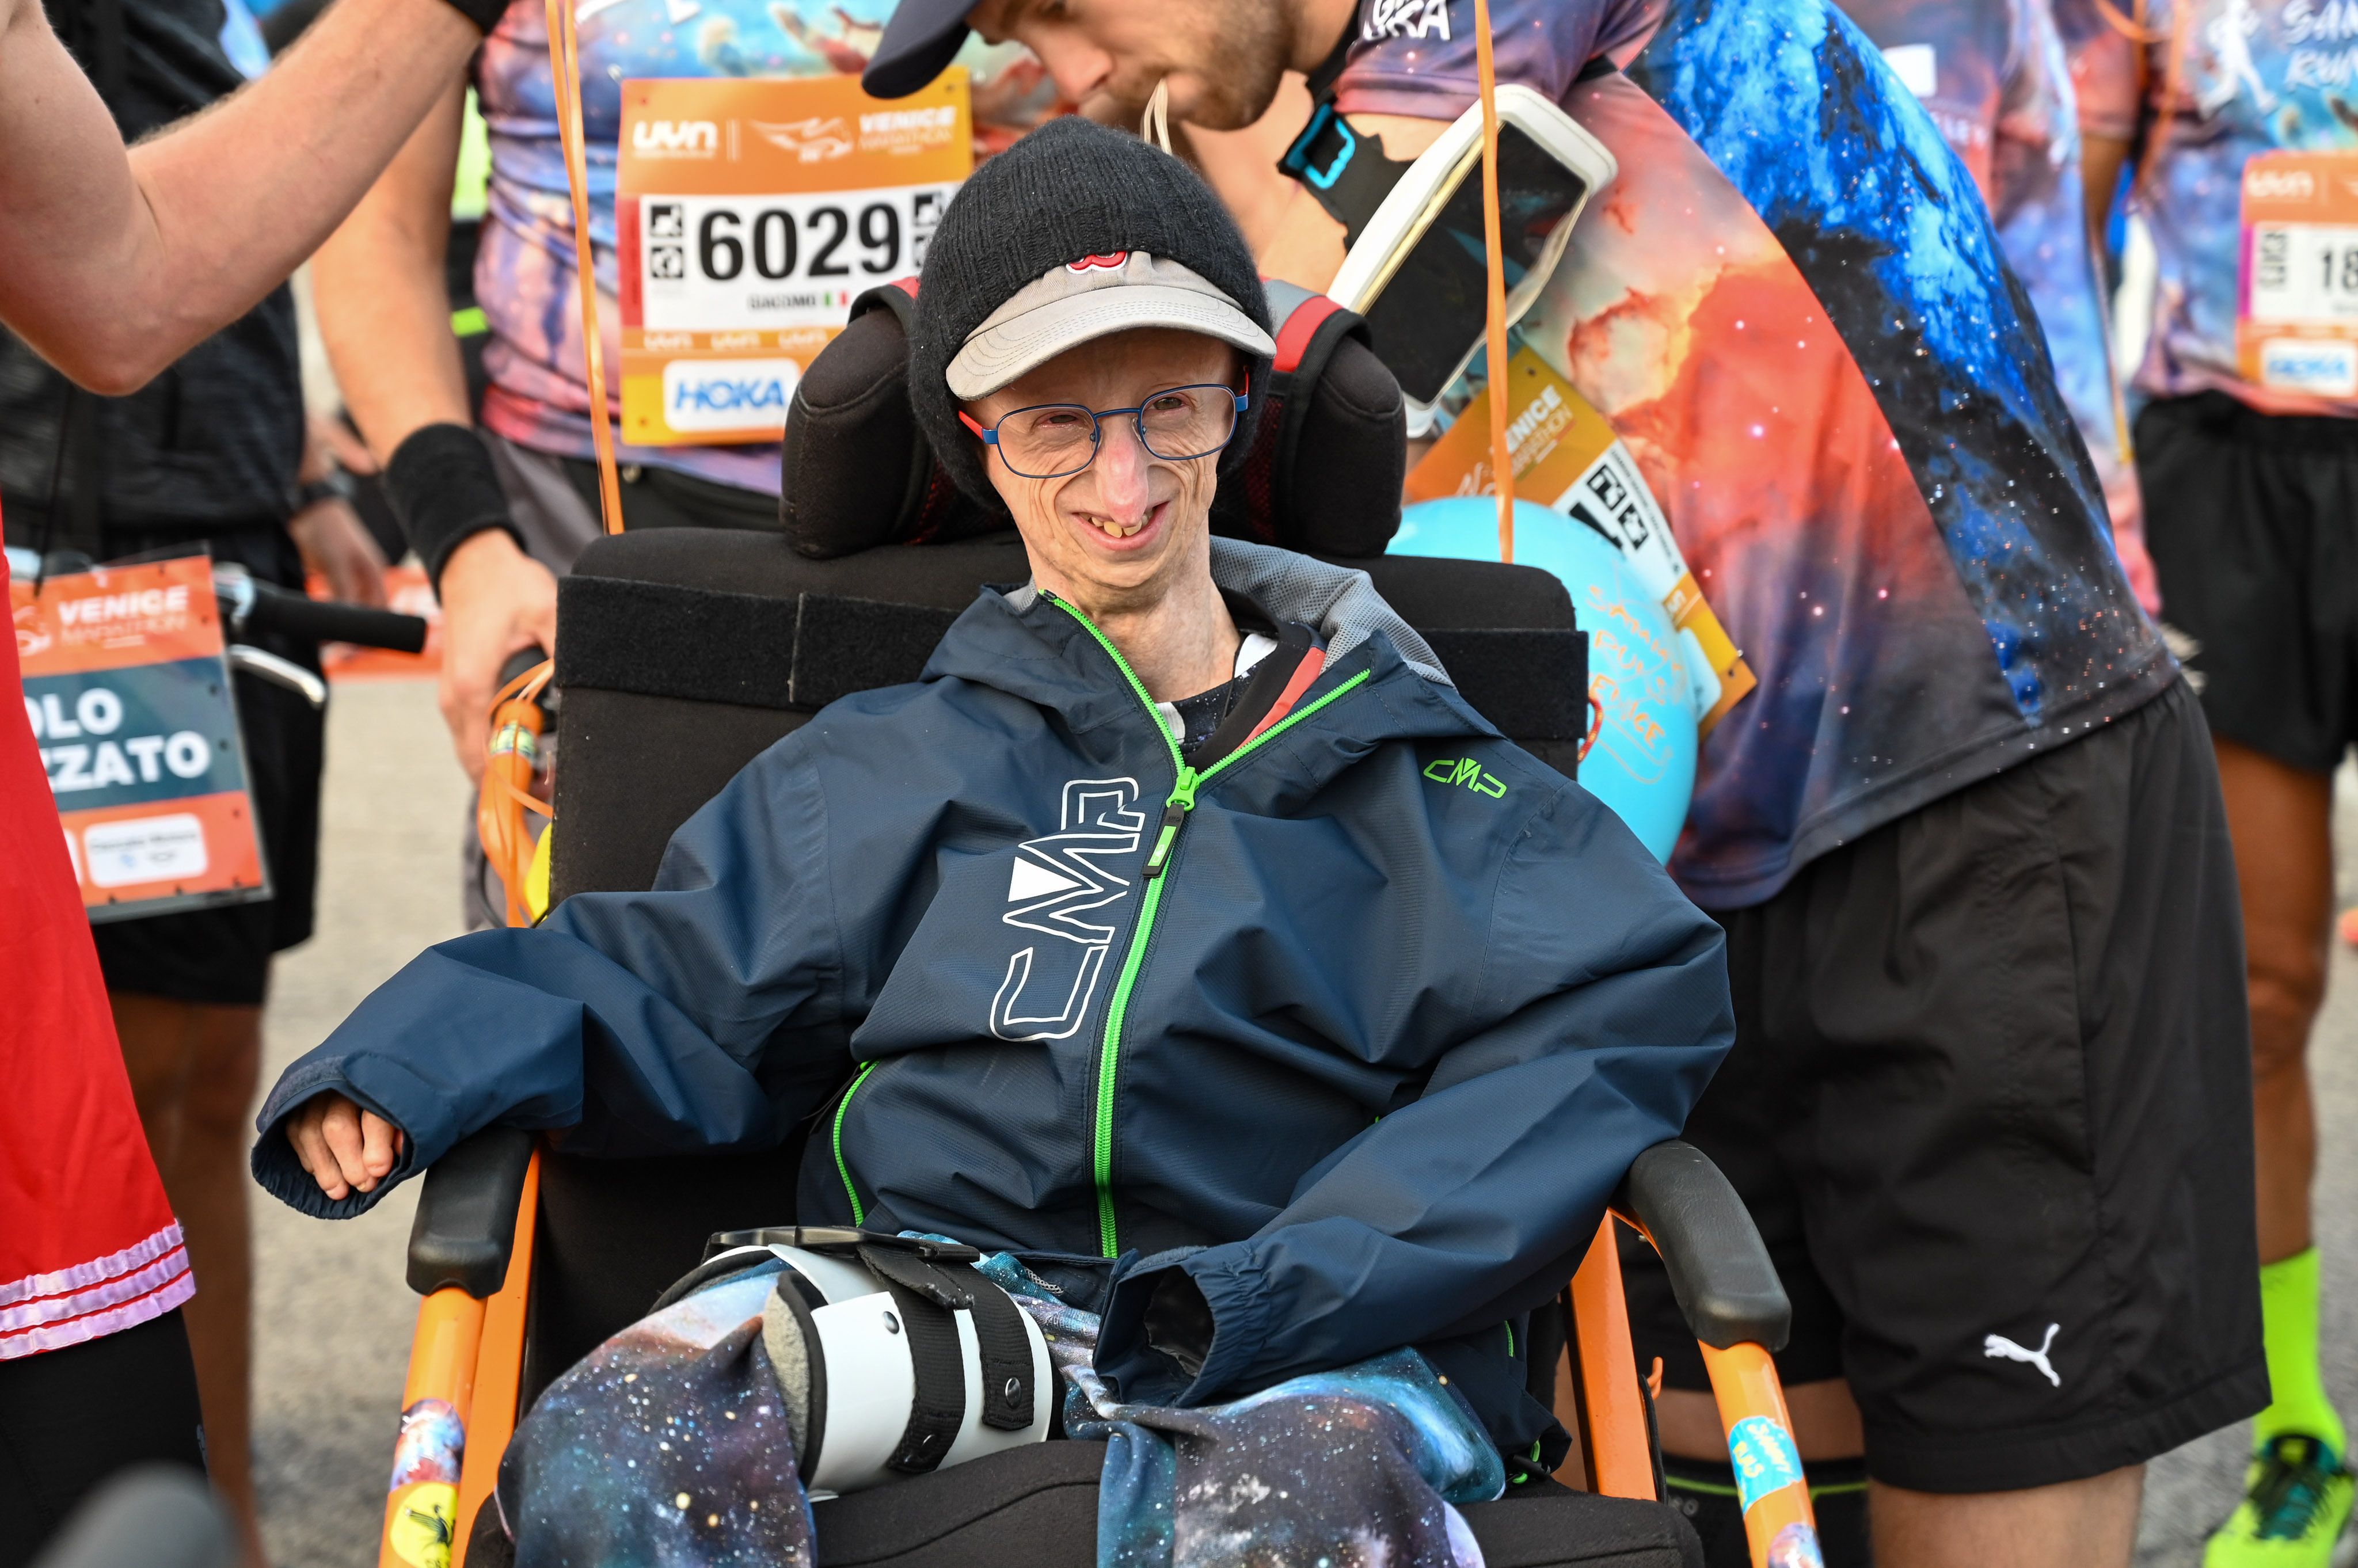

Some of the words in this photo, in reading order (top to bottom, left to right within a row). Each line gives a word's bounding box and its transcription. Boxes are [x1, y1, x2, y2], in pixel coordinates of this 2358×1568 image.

[698, 203, 899, 280] 6029
[675, 381, 785, 409] HOKA
[59, 585, 188, 626] VENICE
[1423, 757, 1507, 798] CMP
